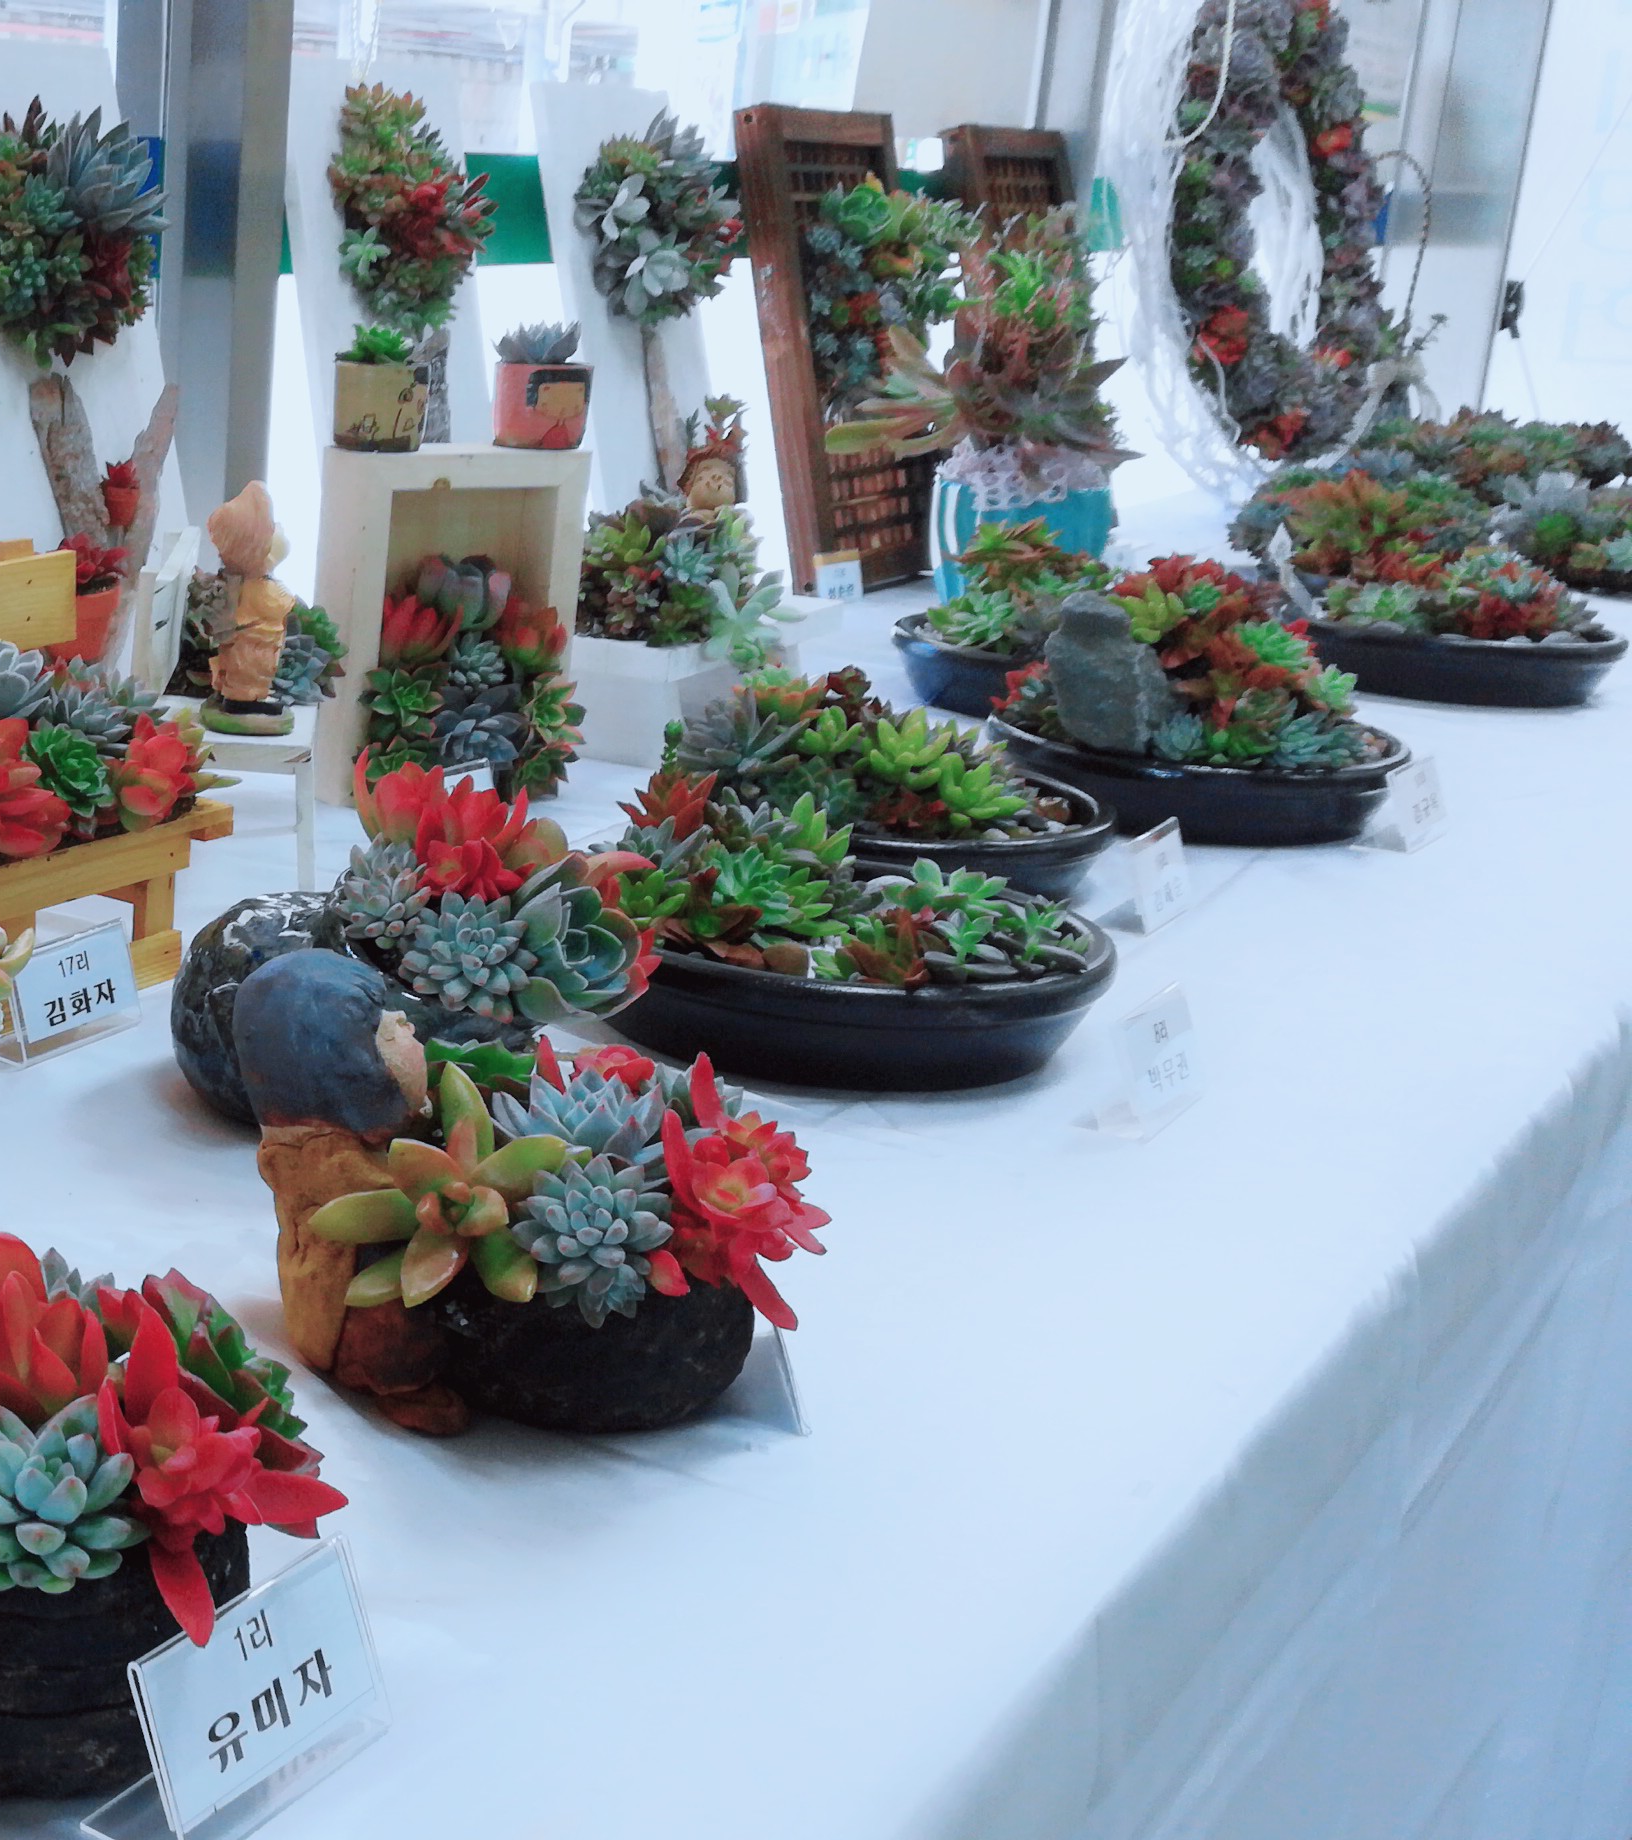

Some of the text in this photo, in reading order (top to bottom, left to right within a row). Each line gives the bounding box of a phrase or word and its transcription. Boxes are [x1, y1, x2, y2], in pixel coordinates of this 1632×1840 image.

[58, 950, 90, 977] 17리
[44, 978, 116, 1027] 김화자
[234, 1609, 273, 1661] 1리
[208, 1648, 332, 1773] 유미자
